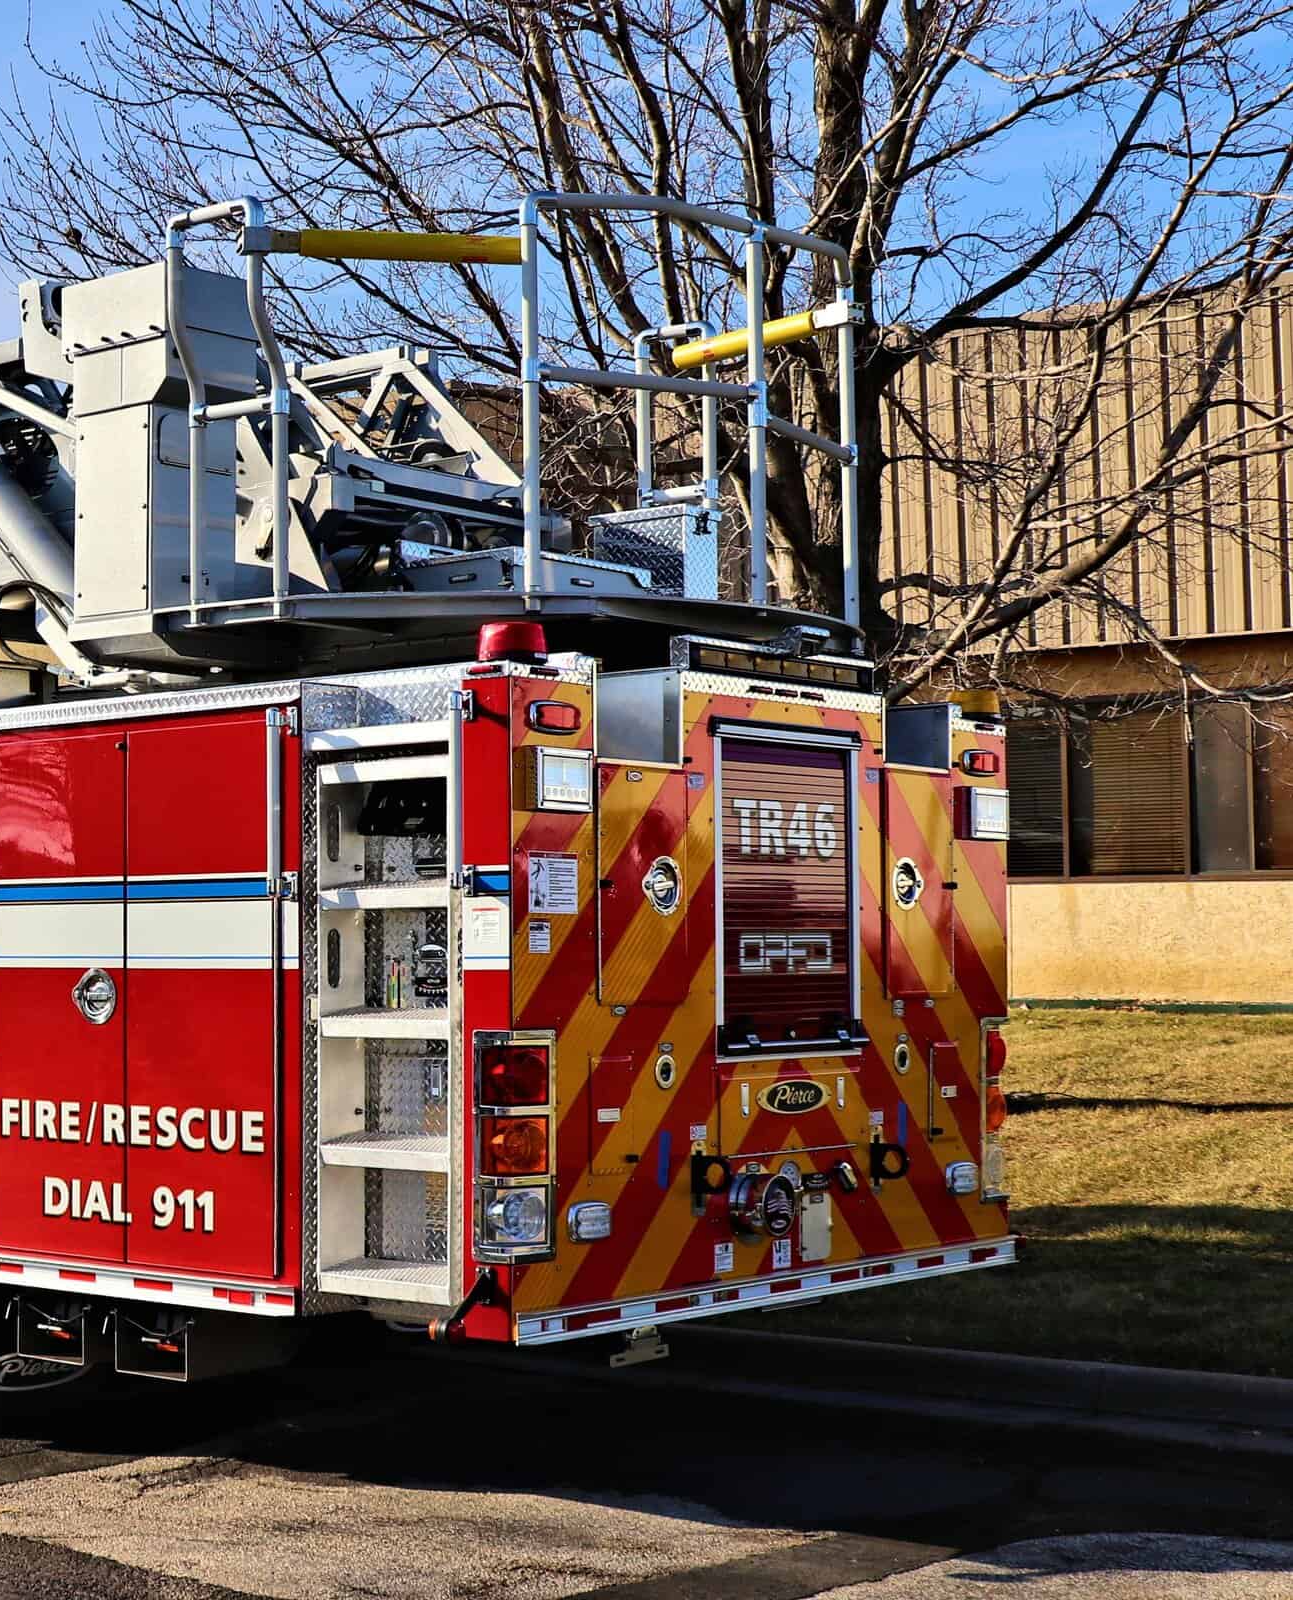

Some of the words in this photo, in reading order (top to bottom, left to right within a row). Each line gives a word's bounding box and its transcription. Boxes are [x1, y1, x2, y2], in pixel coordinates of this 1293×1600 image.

[733, 798, 837, 861] TR46
[773, 1085, 815, 1109] Pierce
[1, 1098, 265, 1153] FIRE/RESCUE
[43, 1176, 133, 1224] DIAL
[152, 1185, 215, 1232] 911
